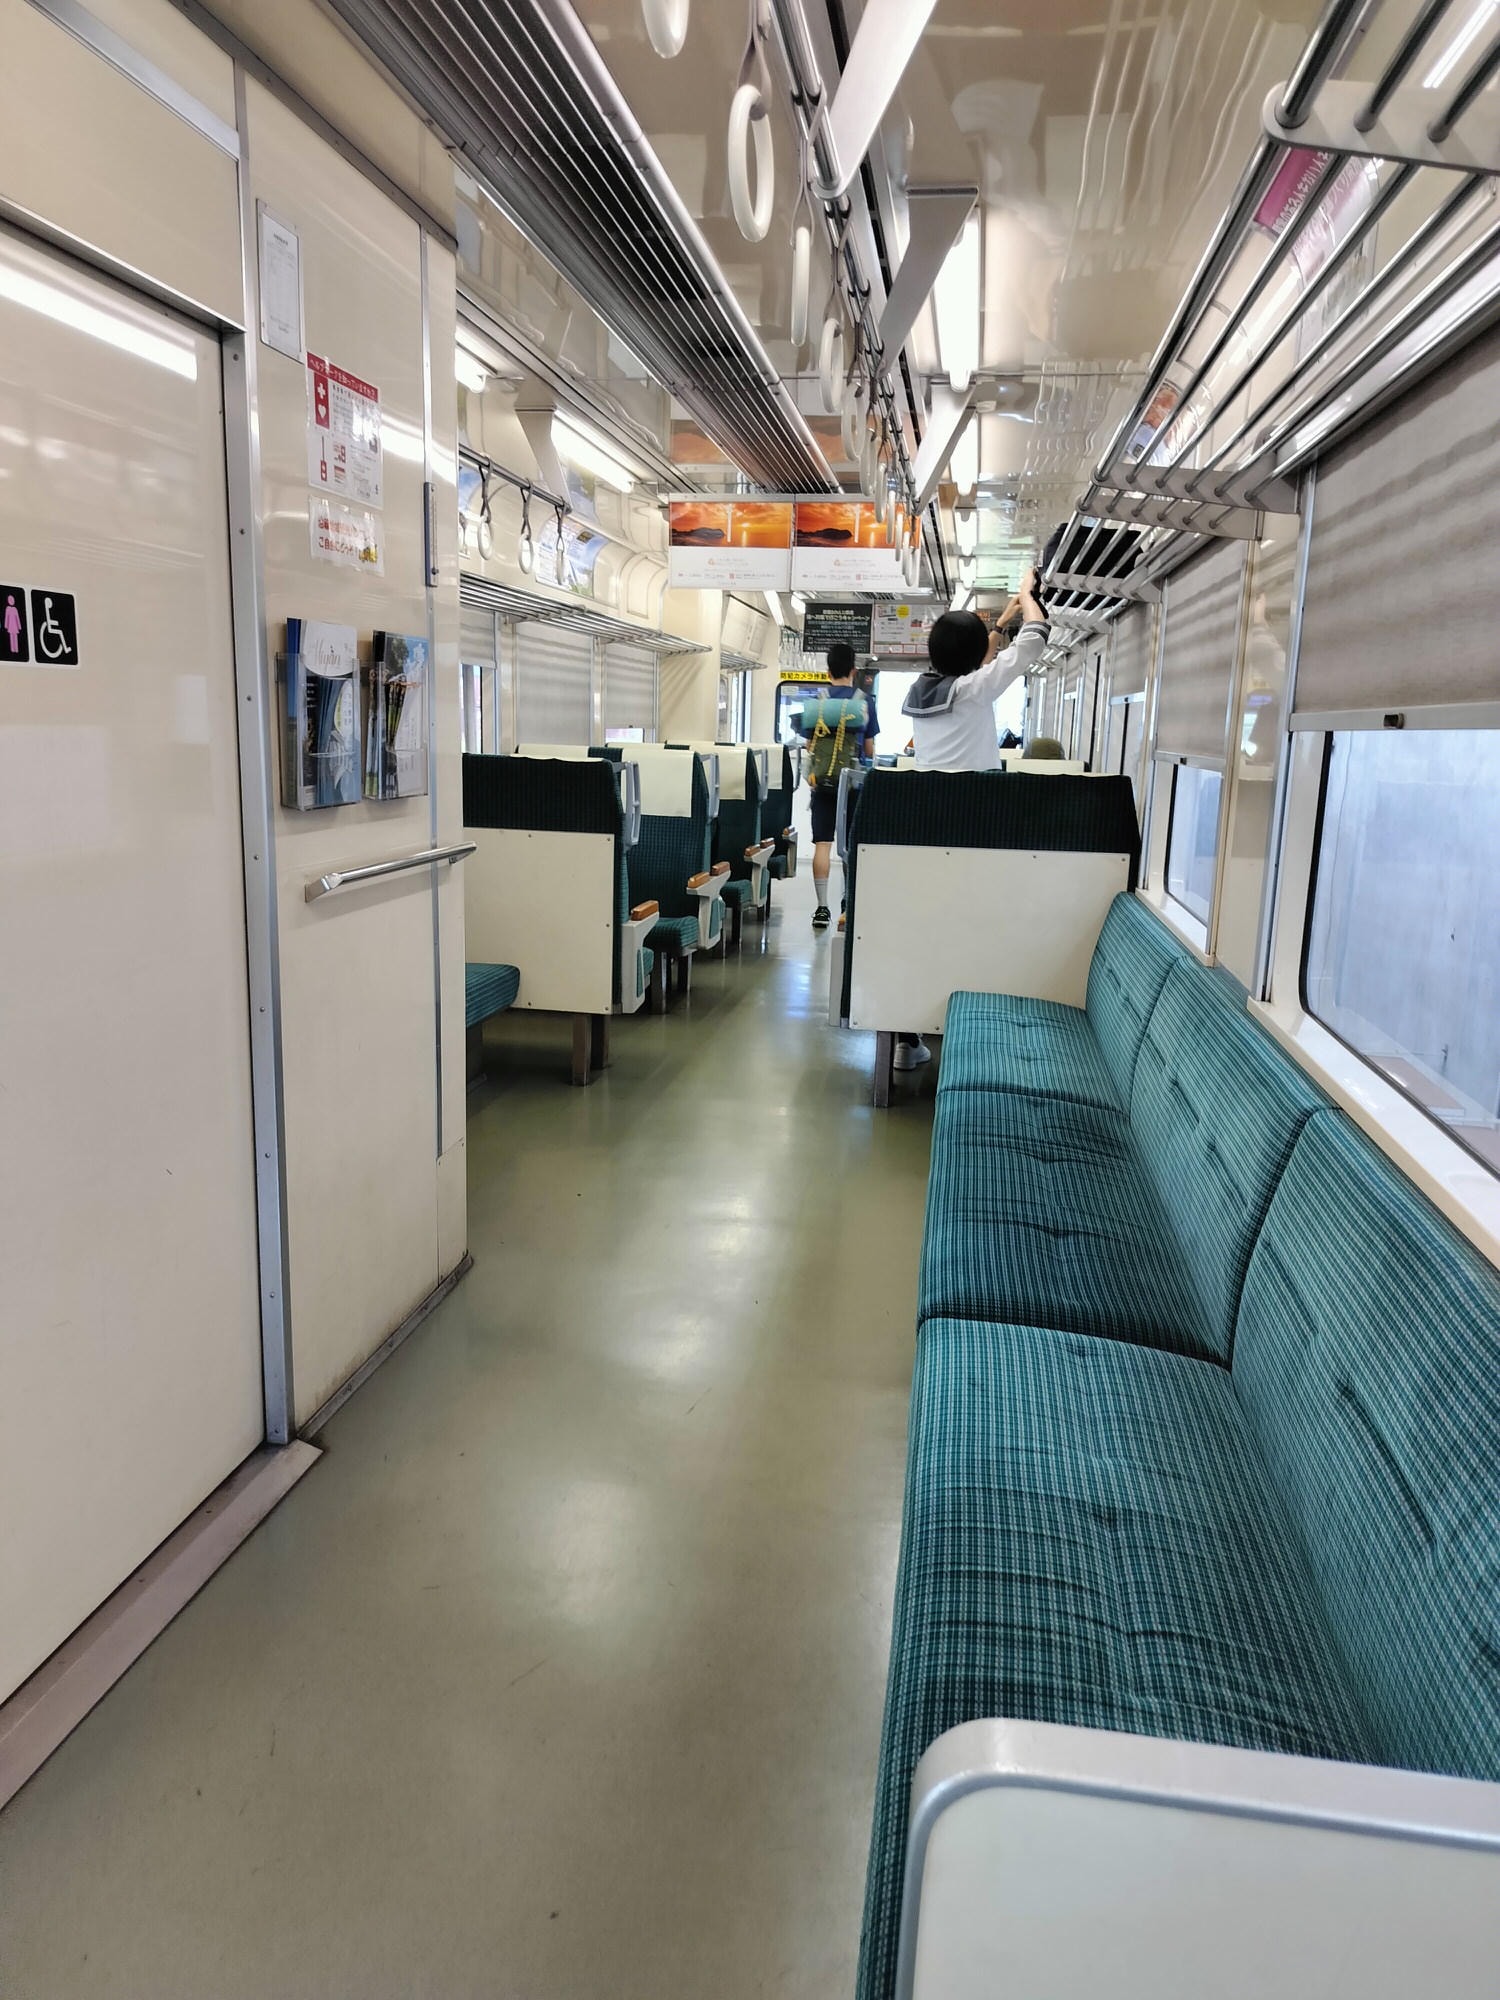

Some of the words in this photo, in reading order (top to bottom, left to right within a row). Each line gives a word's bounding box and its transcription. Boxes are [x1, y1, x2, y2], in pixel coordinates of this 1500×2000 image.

[309, 359, 376, 400] ヘルプークを知っていますか？
[780, 672, 831, 680] 防犯カメラ作動
